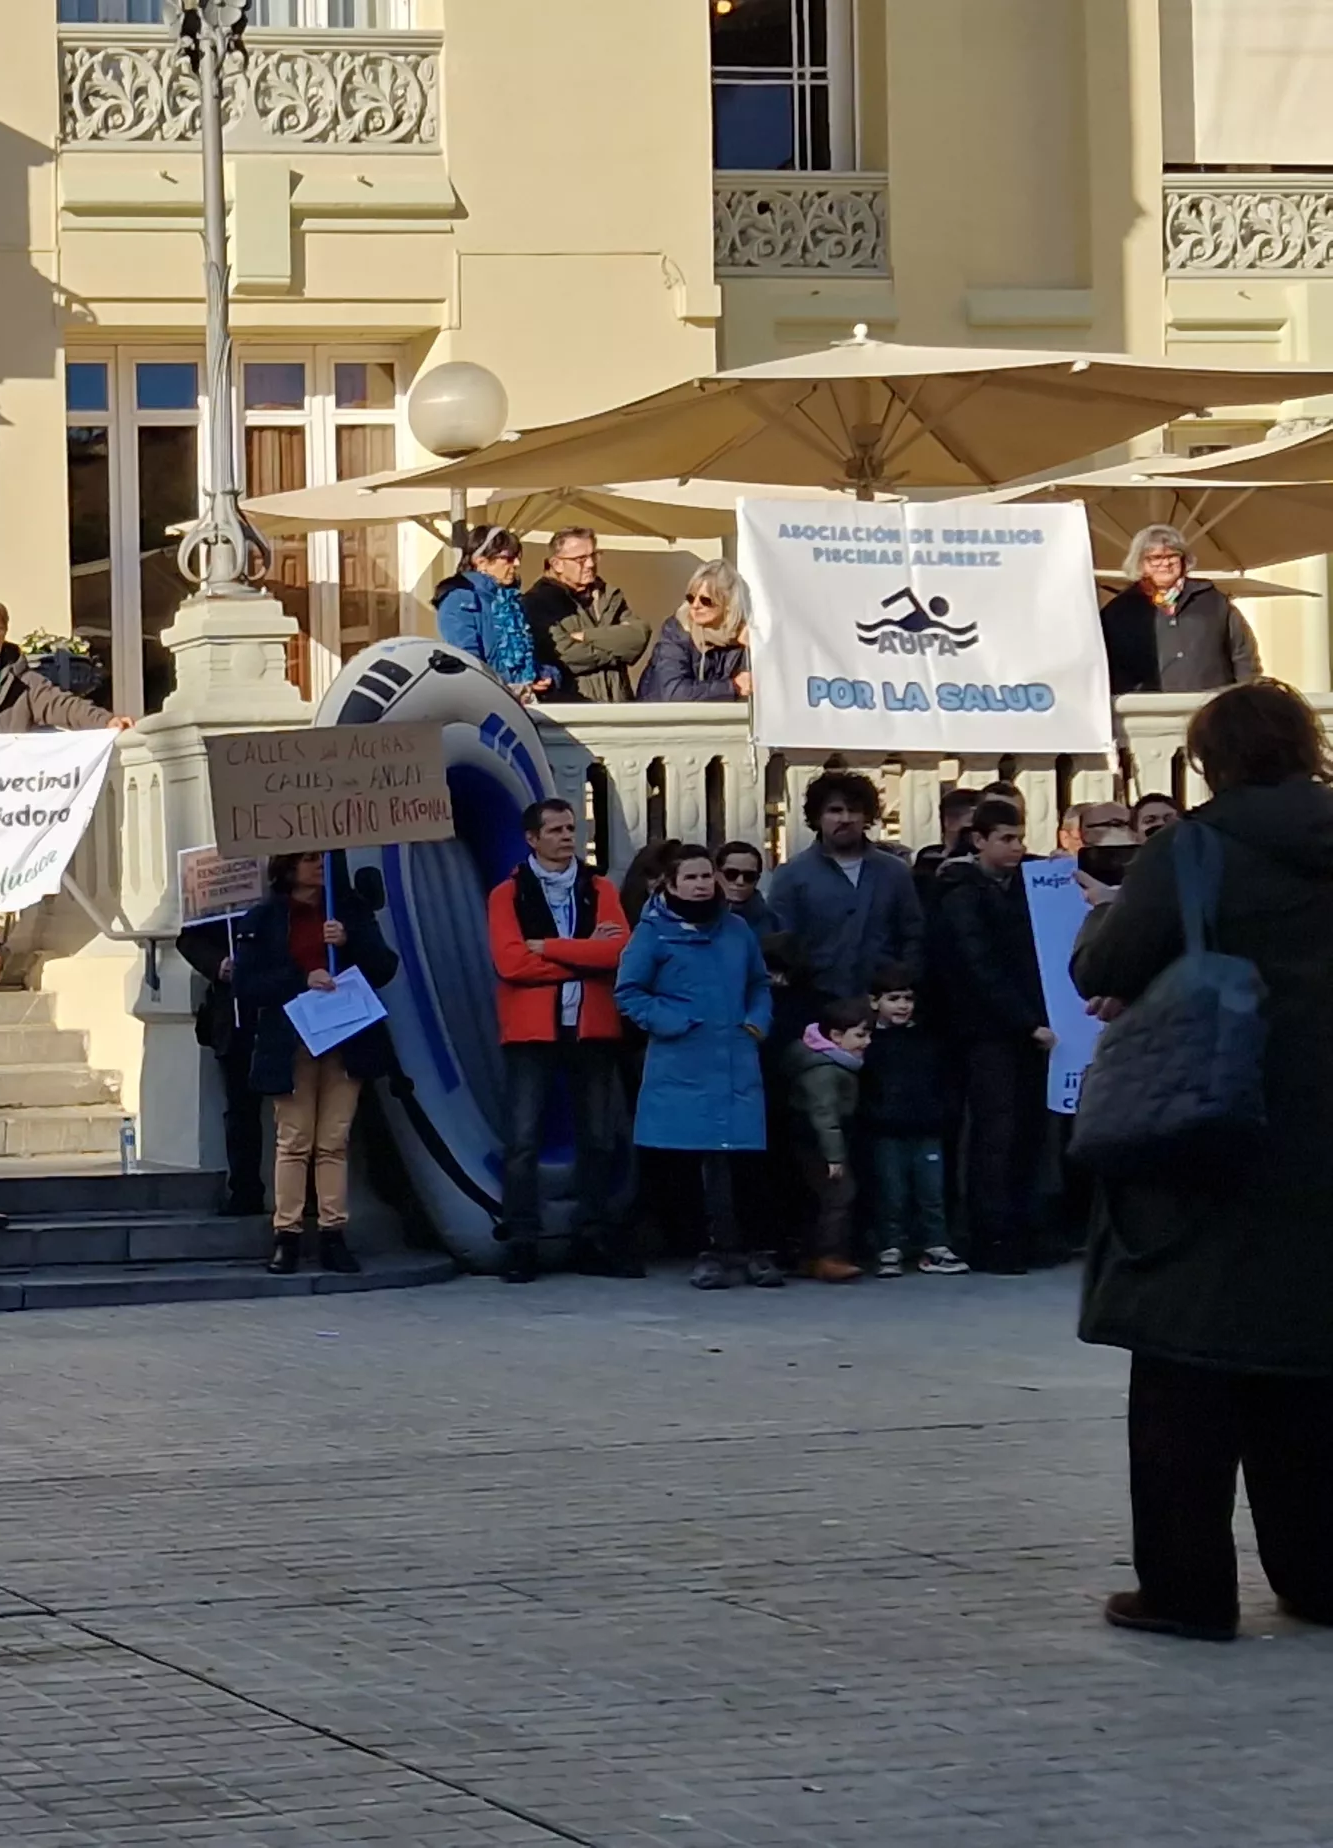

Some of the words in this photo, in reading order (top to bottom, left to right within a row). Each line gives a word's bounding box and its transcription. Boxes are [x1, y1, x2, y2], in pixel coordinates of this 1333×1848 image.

[778, 524, 901, 544] ASOCIACIÓN
[908, 528, 934, 544] DE
[942, 528, 1045, 545] USUARIOS
[813, 547, 904, 565] PISCINAS
[878, 631, 958, 657] AUPA
[807, 676, 876, 710] POR
[882, 682, 930, 712] LA
[936, 682, 1055, 712] SALUD
